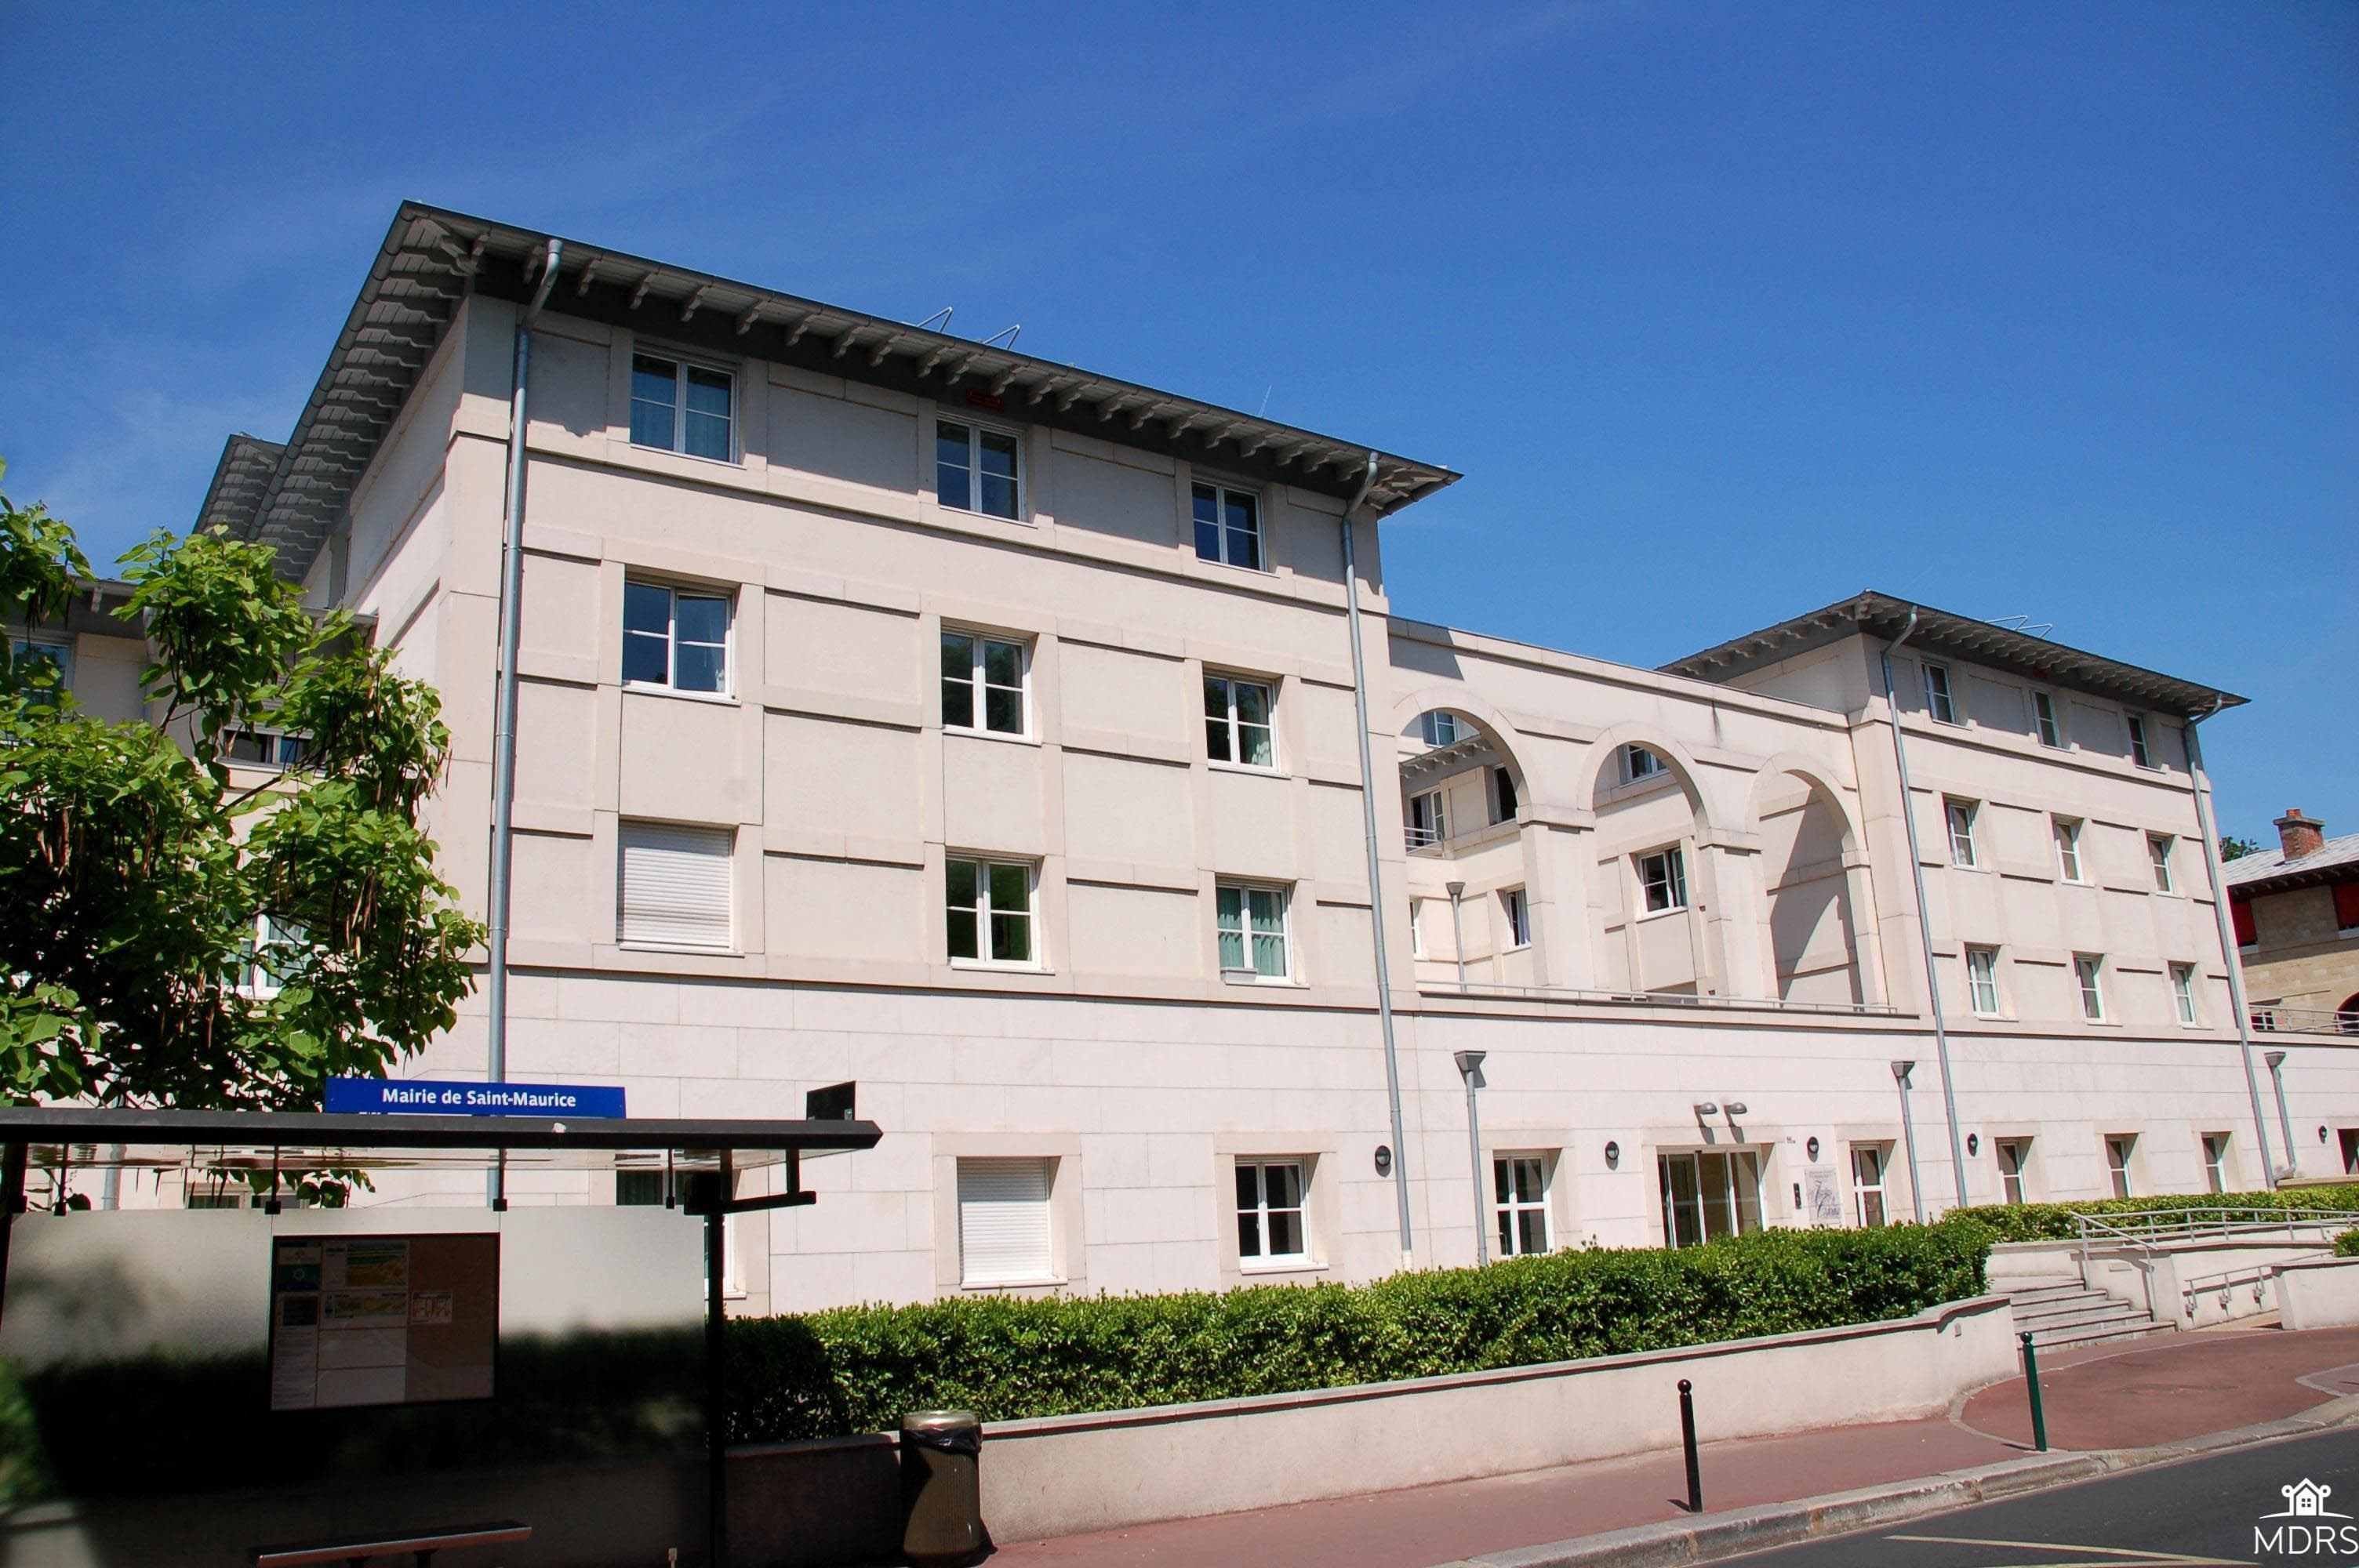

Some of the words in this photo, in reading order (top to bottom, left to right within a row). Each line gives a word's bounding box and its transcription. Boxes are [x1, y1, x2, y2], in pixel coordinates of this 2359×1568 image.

[382, 1088, 437, 1104] Mairie
[442, 1090, 462, 1105] de
[467, 1091, 576, 1107] Saint-Maurice
